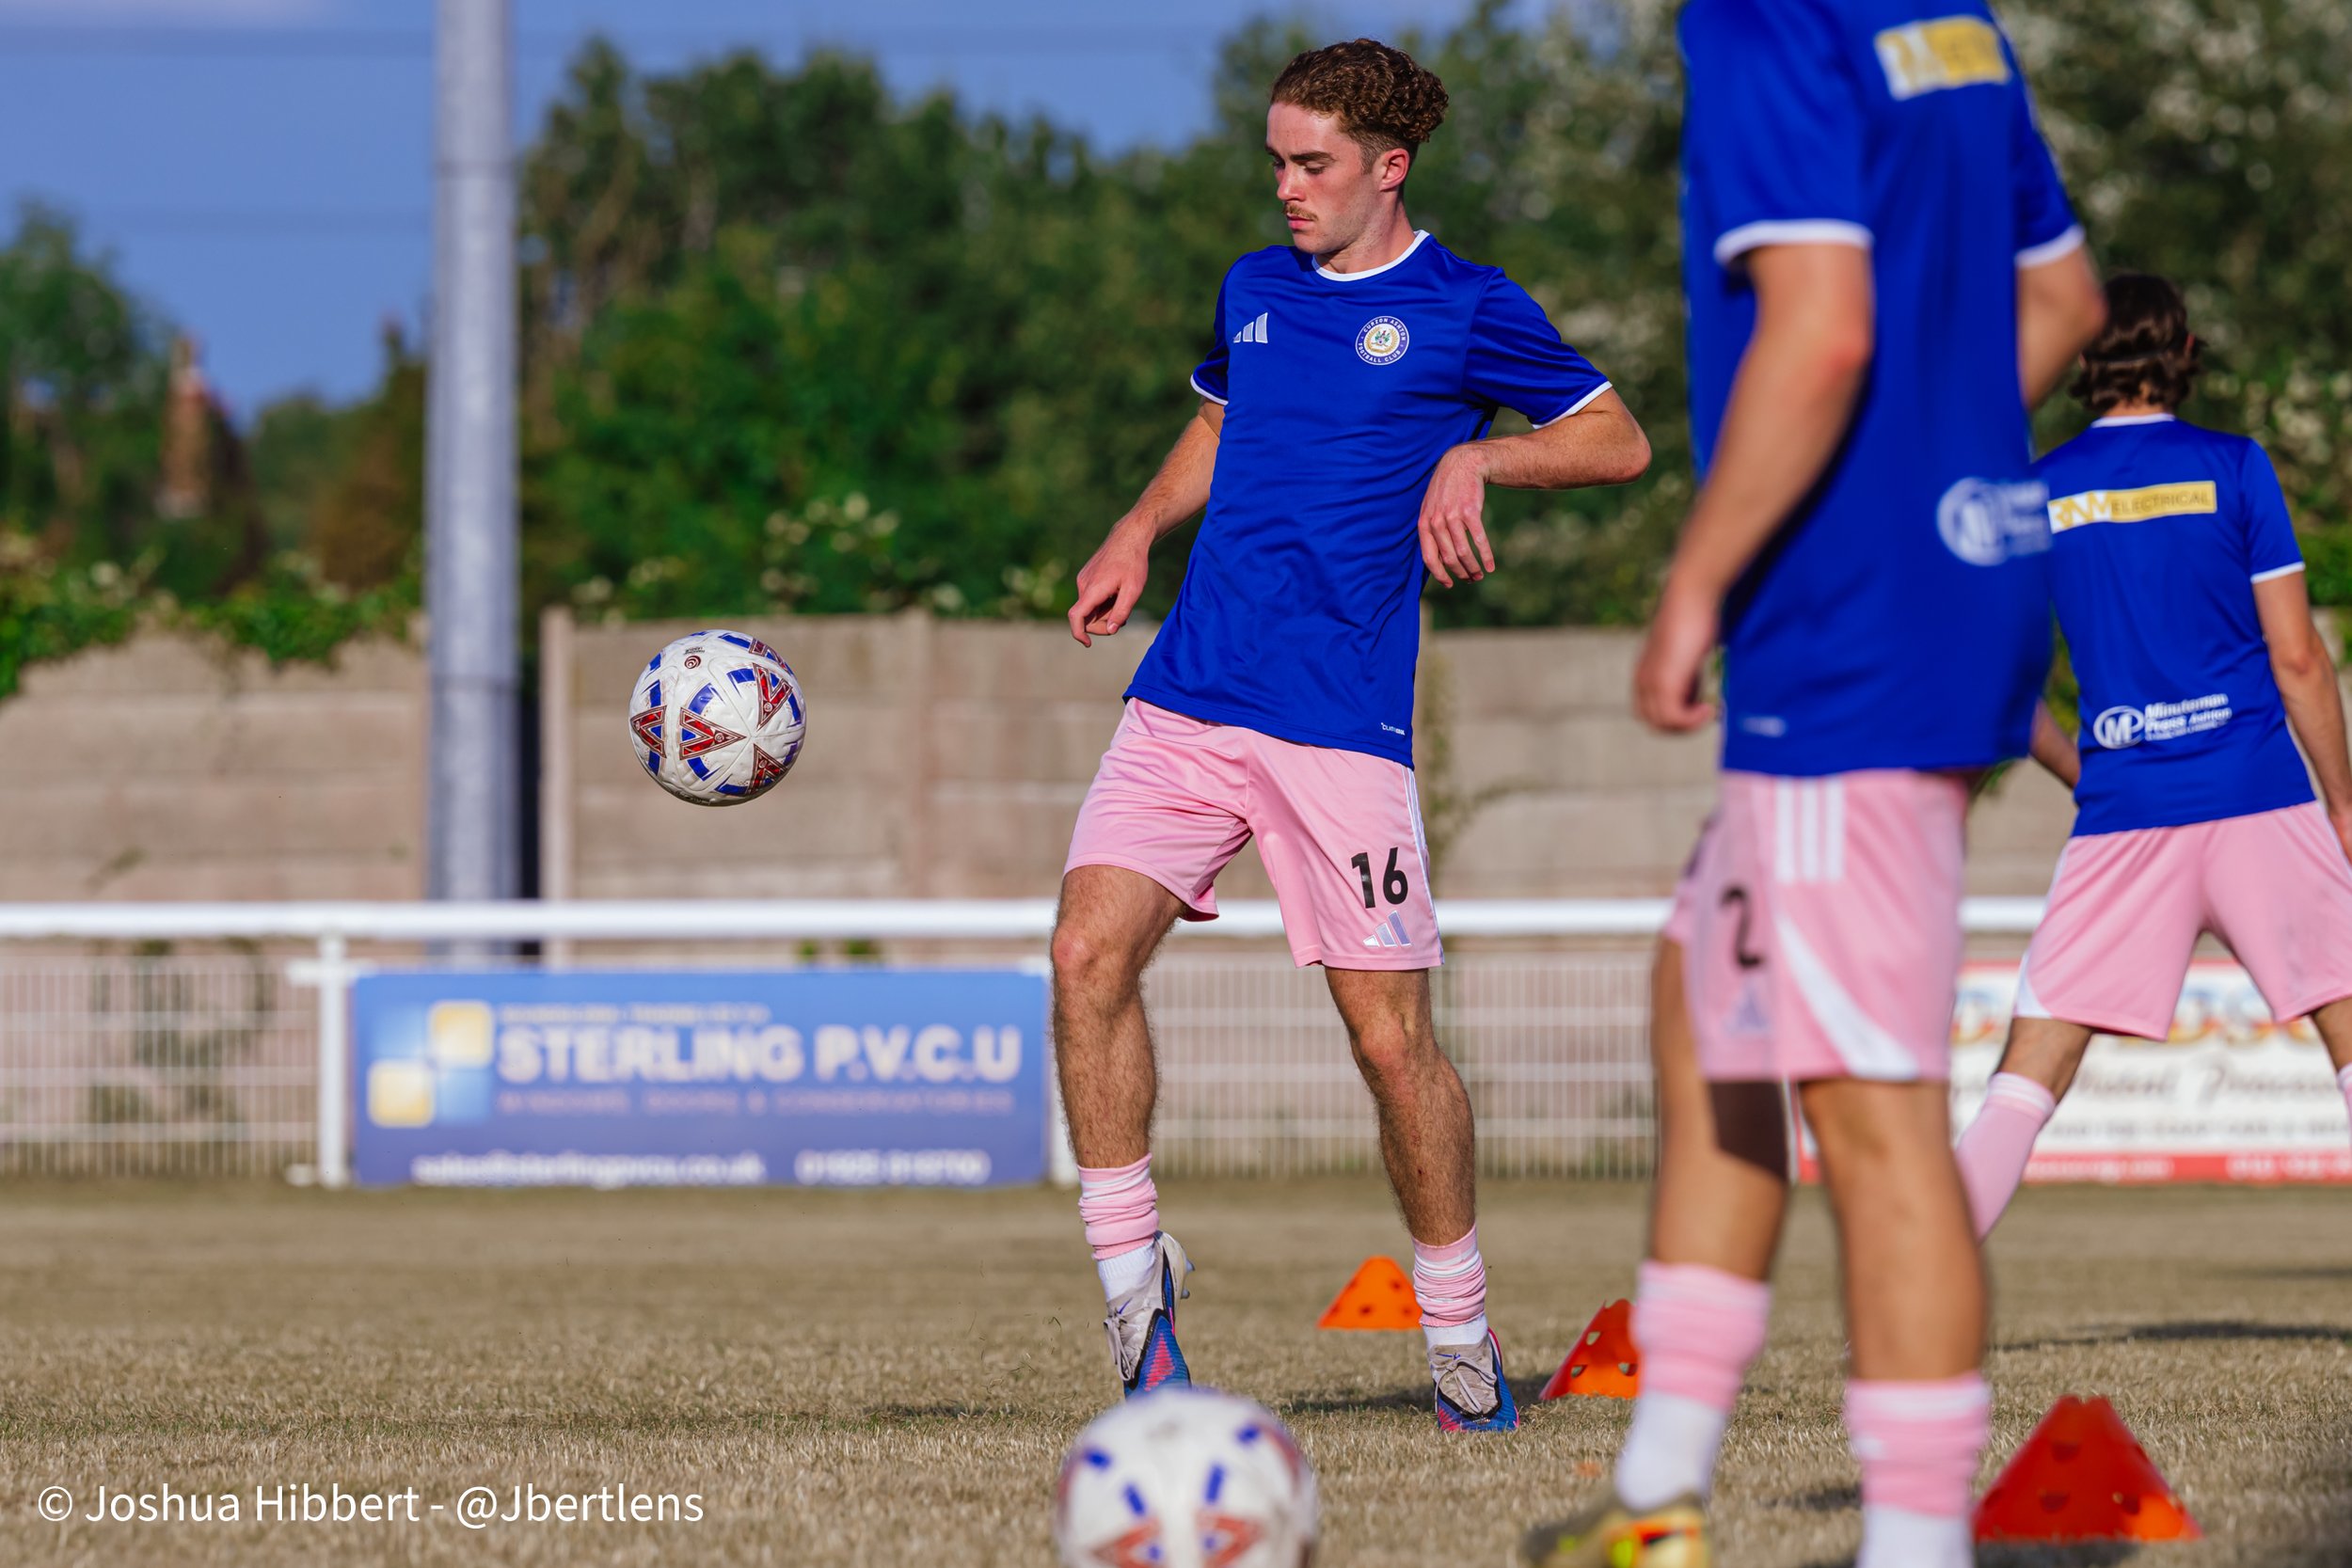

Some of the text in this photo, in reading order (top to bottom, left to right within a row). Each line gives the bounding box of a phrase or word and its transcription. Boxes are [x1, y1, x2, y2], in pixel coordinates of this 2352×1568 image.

[1363, 318, 1406, 341] CURZON ASHTON
[1358, 342, 1401, 363] FOOTBALL CLUB
[2111, 489, 2210, 515] ELECTRICAL
[1351, 847, 1409, 910] 16
[1720, 884, 1765, 970] 2
[499, 1026, 804, 1083] STERLING
